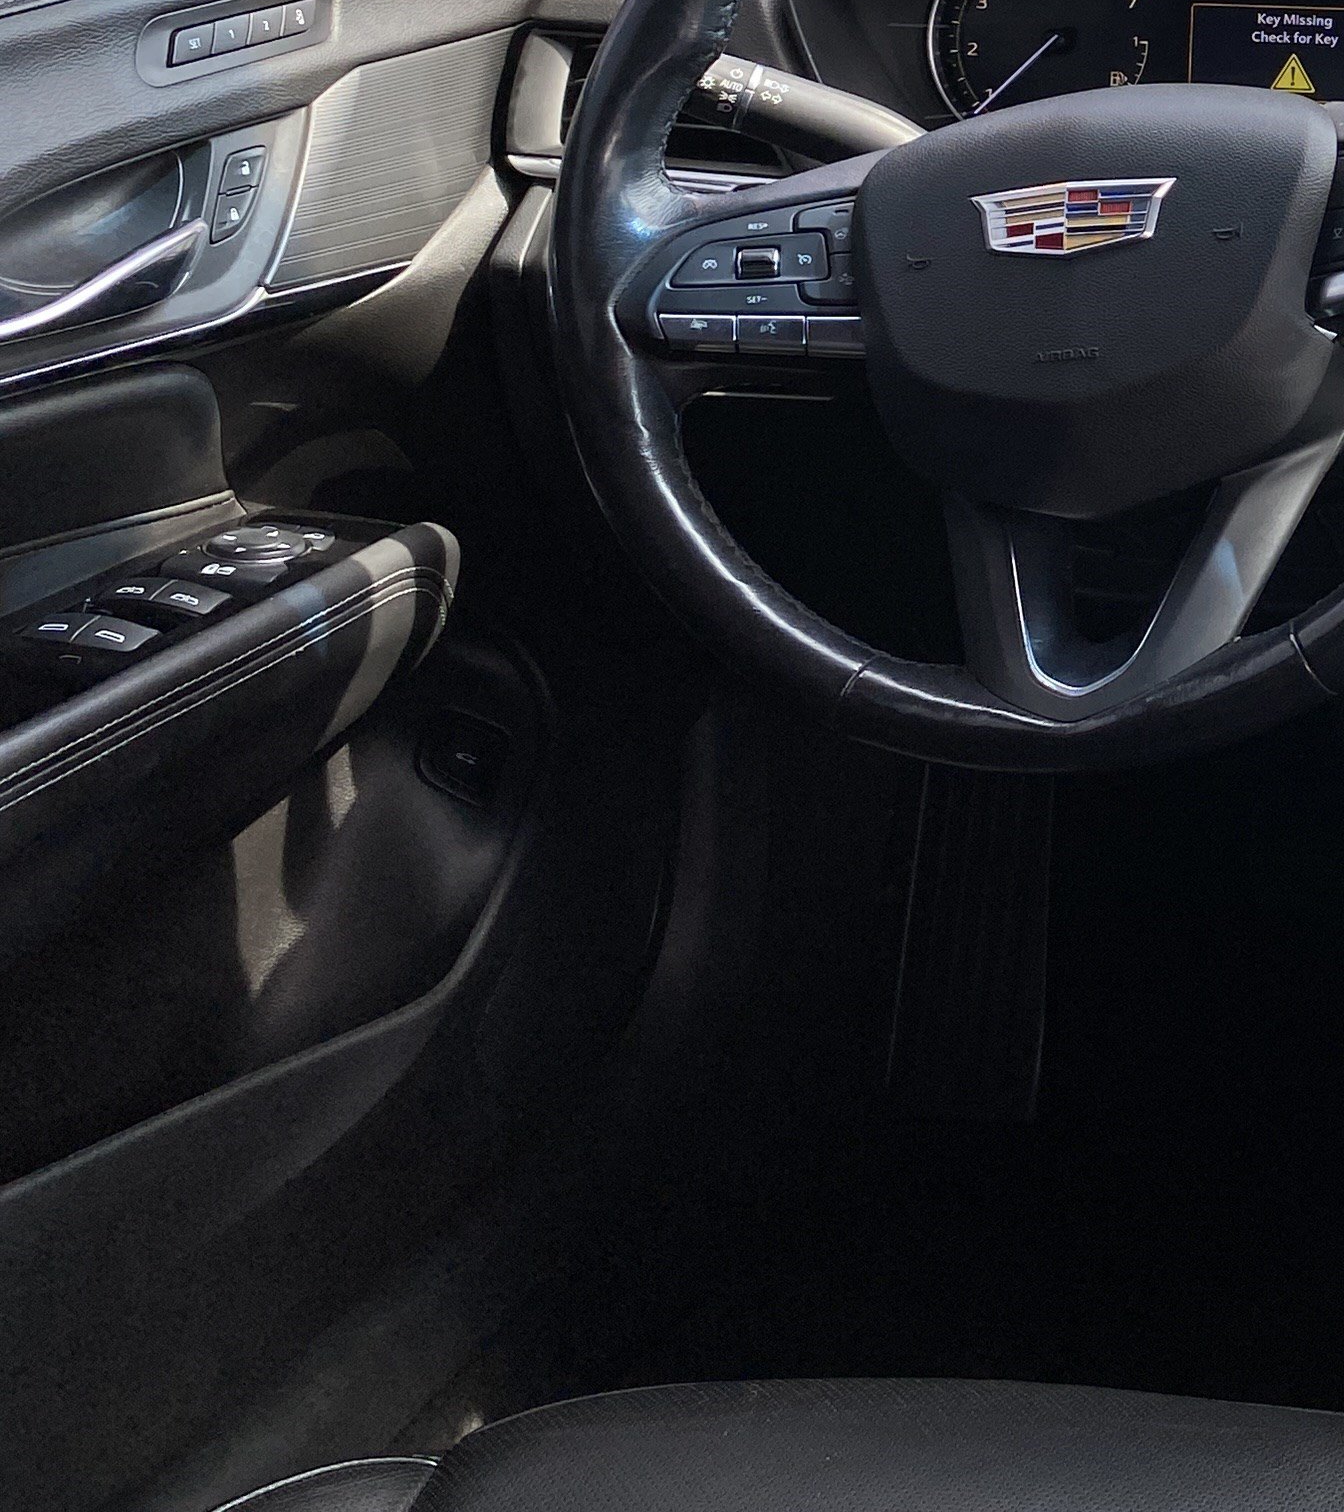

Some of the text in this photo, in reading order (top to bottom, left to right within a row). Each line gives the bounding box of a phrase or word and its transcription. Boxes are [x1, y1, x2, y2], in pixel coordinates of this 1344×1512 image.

[1257, 13, 1333, 29] Key Missing
[188, 37, 202, 50] SET
[228, 29, 235, 39] 1
[1251, 30, 1339, 49] Check for Key
[966, 42, 979, 57] 2
[720, 79, 743, 92] AUTO
